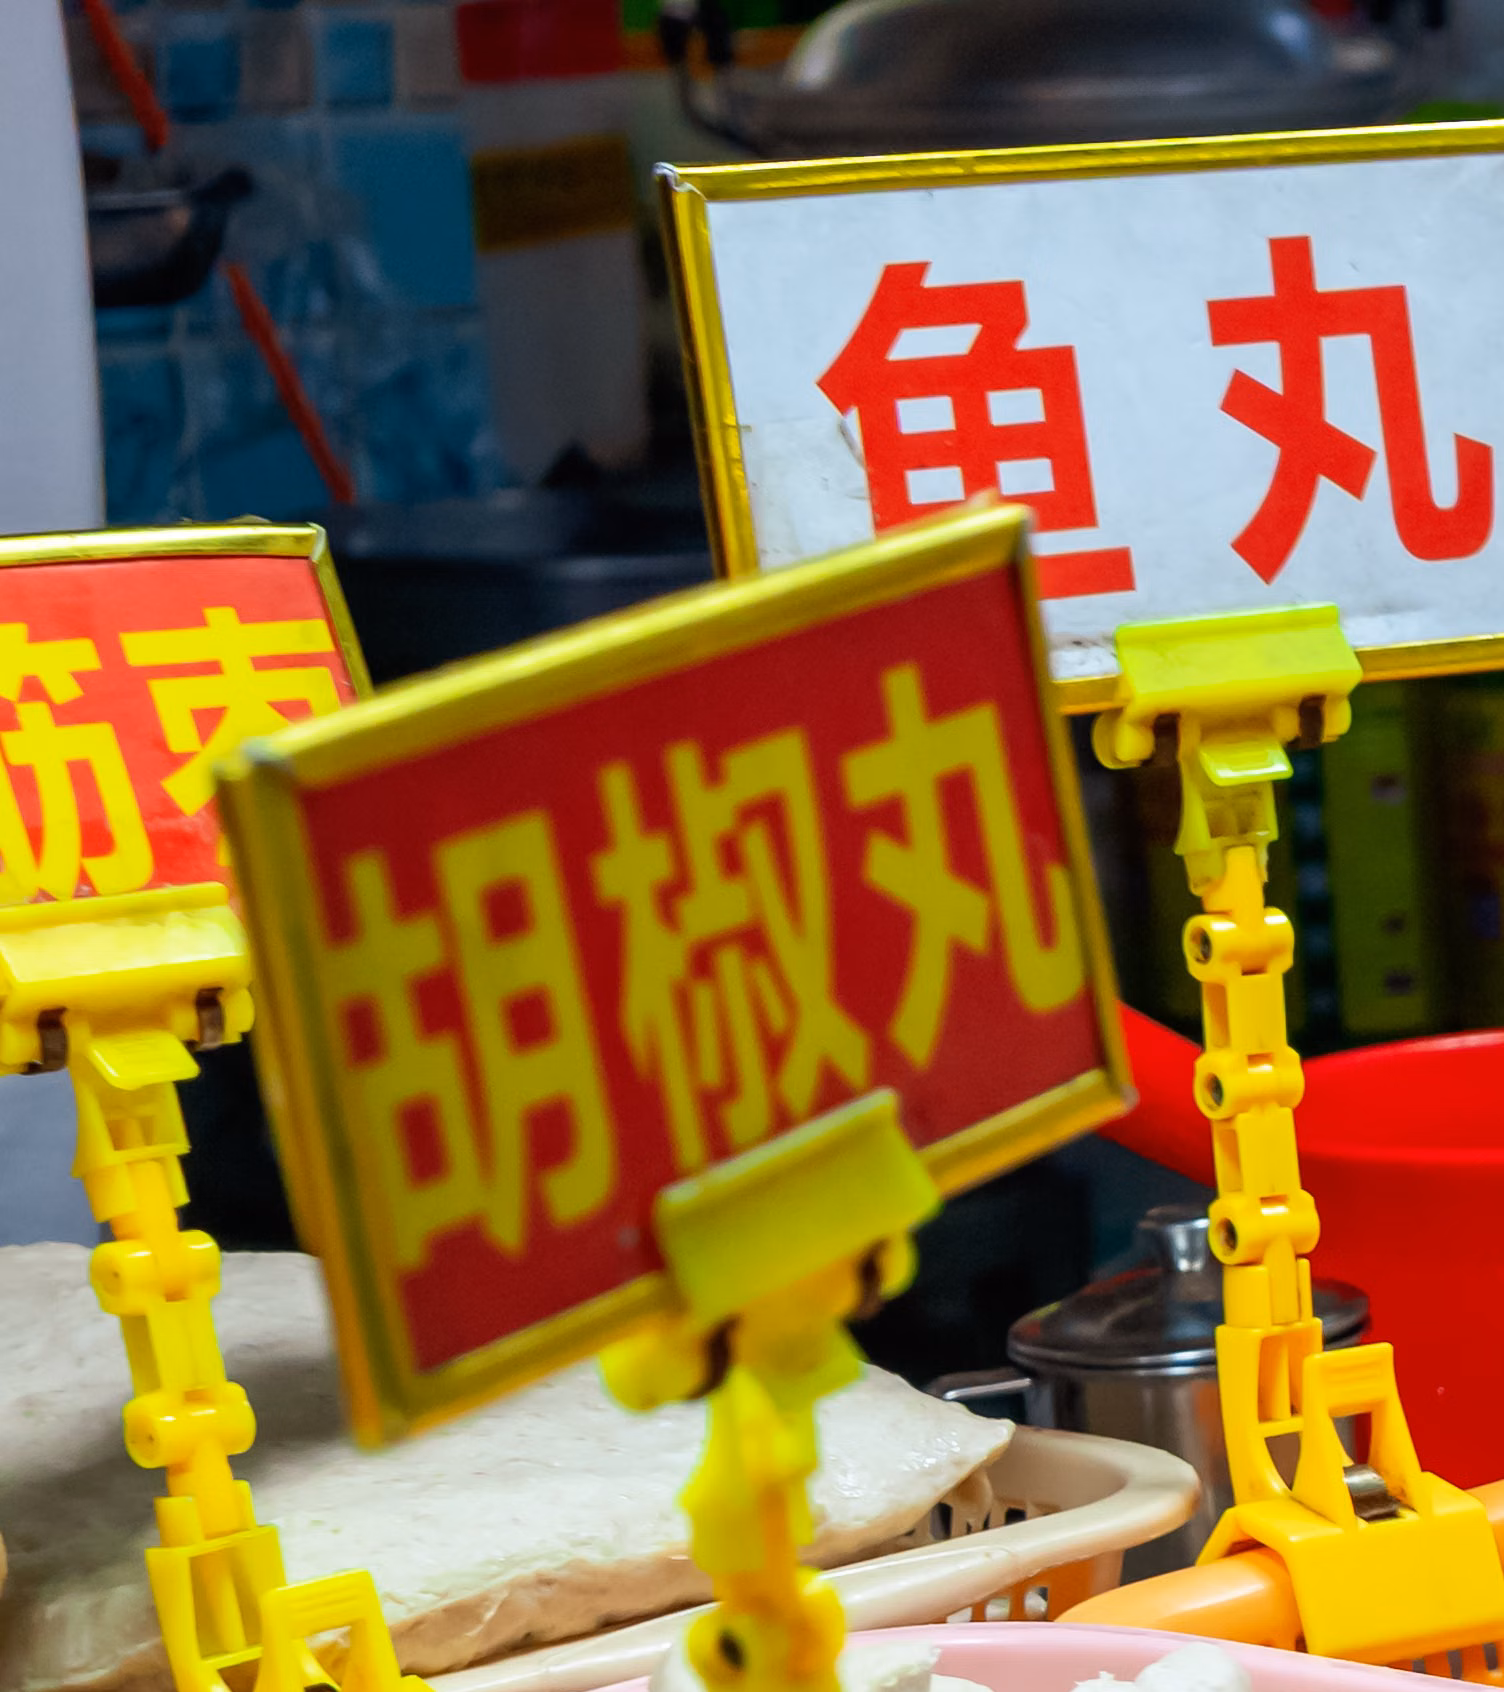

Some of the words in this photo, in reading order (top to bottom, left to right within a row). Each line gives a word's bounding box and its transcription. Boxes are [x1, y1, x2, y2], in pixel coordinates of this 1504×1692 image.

[816, 235, 1494, 600] 鱼丸
[321, 662, 1089, 1273] 胡椒丸
